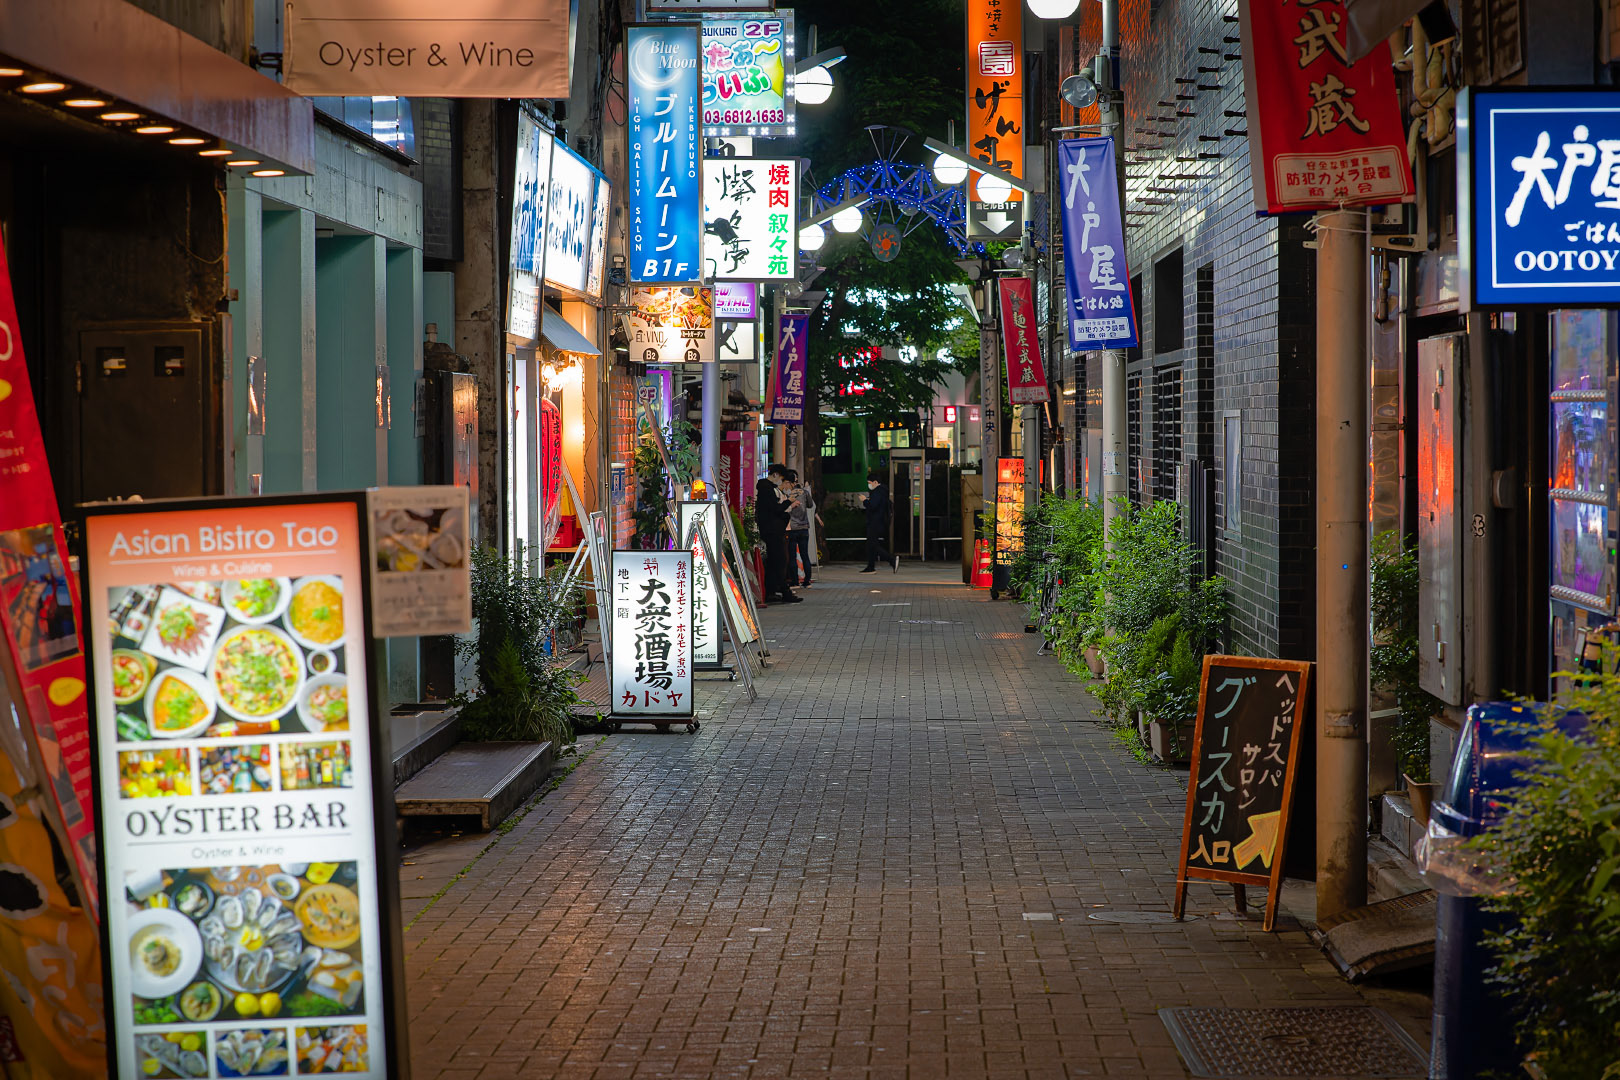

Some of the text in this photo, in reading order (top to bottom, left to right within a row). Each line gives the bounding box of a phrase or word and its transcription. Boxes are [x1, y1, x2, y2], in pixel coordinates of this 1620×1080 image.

[745, 22, 780, 36] 2F
[319, 41, 535, 72] Oyster & Wine
[651, 41, 680, 54] Blue
[658, 56, 697, 68] Moon
[688, 97, 696, 178] IKEBUKURO
[653, 93, 678, 252] ブルームーン
[1286, 166, 1391, 186] 防犯カメラ設置
[768, 164, 789, 275] 焼肉 叙々苑
[1066, 147, 1125, 291] 大戸屋
[643, 259, 689, 277] B1F
[646, 350, 656, 360] B2
[687, 350, 697, 360] B2
[779, 319, 804, 396] 大戸屋
[109, 521, 339, 557] Asian Bistro Tao
[172, 561, 272, 577] Wine & Cuisine
[618, 568, 630, 619] 地下一階
[634, 578, 674, 690] 大衆酒場
[621, 690, 683, 708] カドヤ
[1258, 673, 1295, 787] ヘッドスパ
[1200, 676, 1257, 834] グースカ
[1238, 743, 1262, 809] サロン
[126, 801, 349, 837] OYSTER BAR
[191, 846, 233, 860] Oyster
[252, 844, 285, 856] Wine
[1189, 834, 1231, 866] 入口
